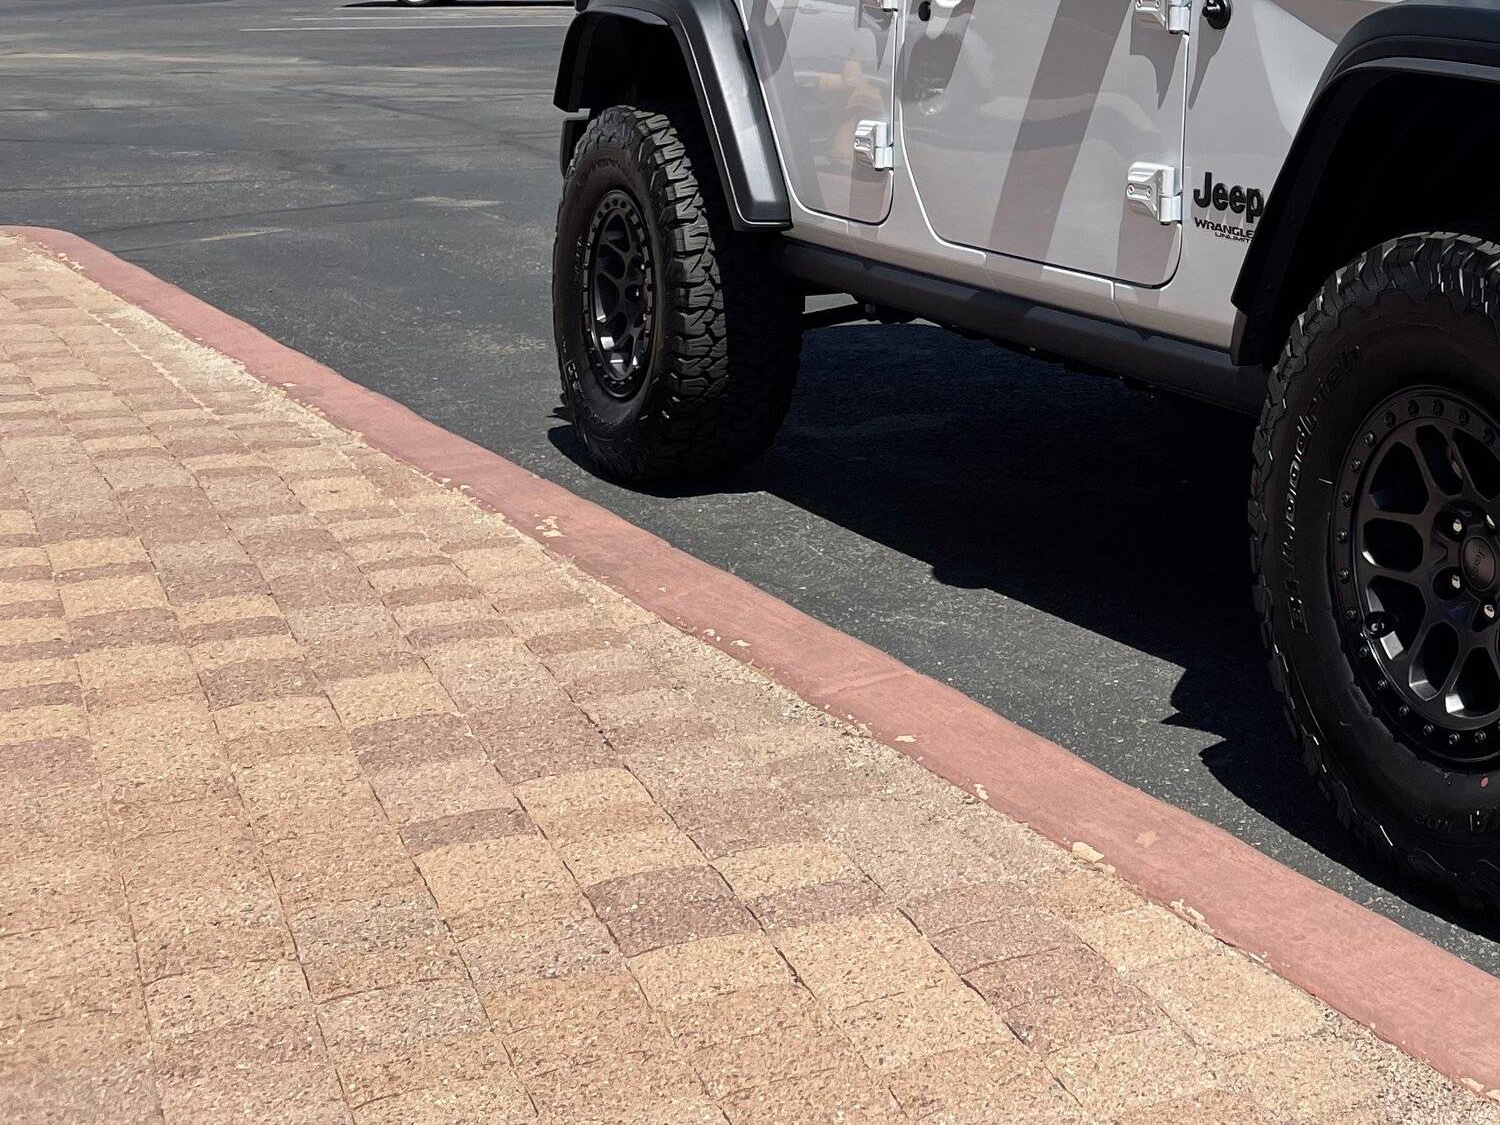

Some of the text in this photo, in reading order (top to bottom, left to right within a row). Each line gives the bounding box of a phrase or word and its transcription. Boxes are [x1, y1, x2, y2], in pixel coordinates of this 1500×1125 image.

[1193, 171, 1265, 224] Jeep
[1194, 216, 1256, 239] WRANGLE
[1214, 231, 1252, 244] UNLIMIT
